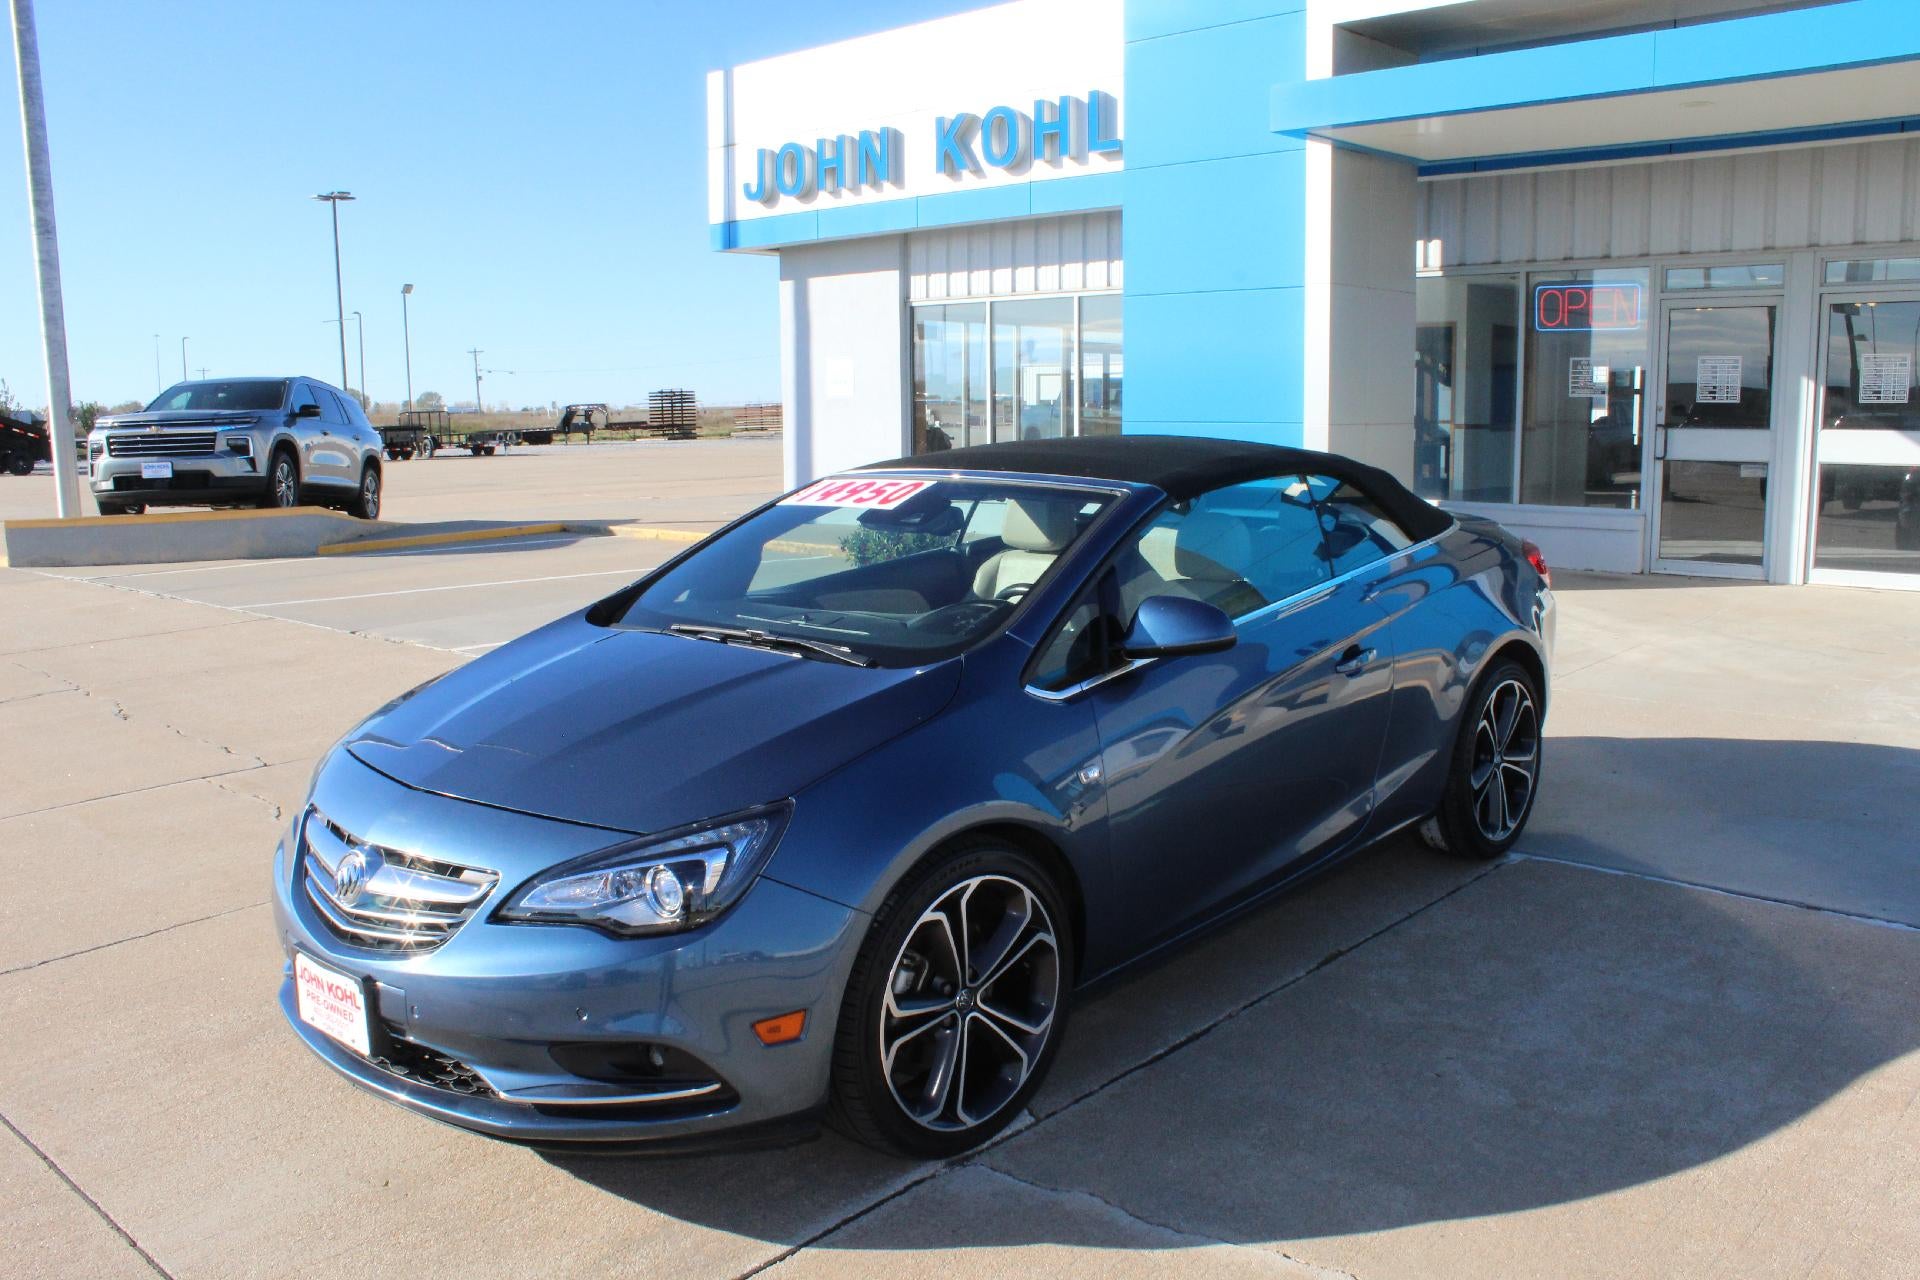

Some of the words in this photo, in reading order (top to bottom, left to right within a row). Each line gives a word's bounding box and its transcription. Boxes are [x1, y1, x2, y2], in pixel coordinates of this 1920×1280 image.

[743, 126, 895, 203] JOHN
[935, 89, 1123, 174] KOHL
[1540, 287, 1638, 327] OPEN
[299, 965, 325, 993] JOHN
[326, 980, 362, 1011] KOHL
[306, 989, 354, 1023] PRE-OWNED
